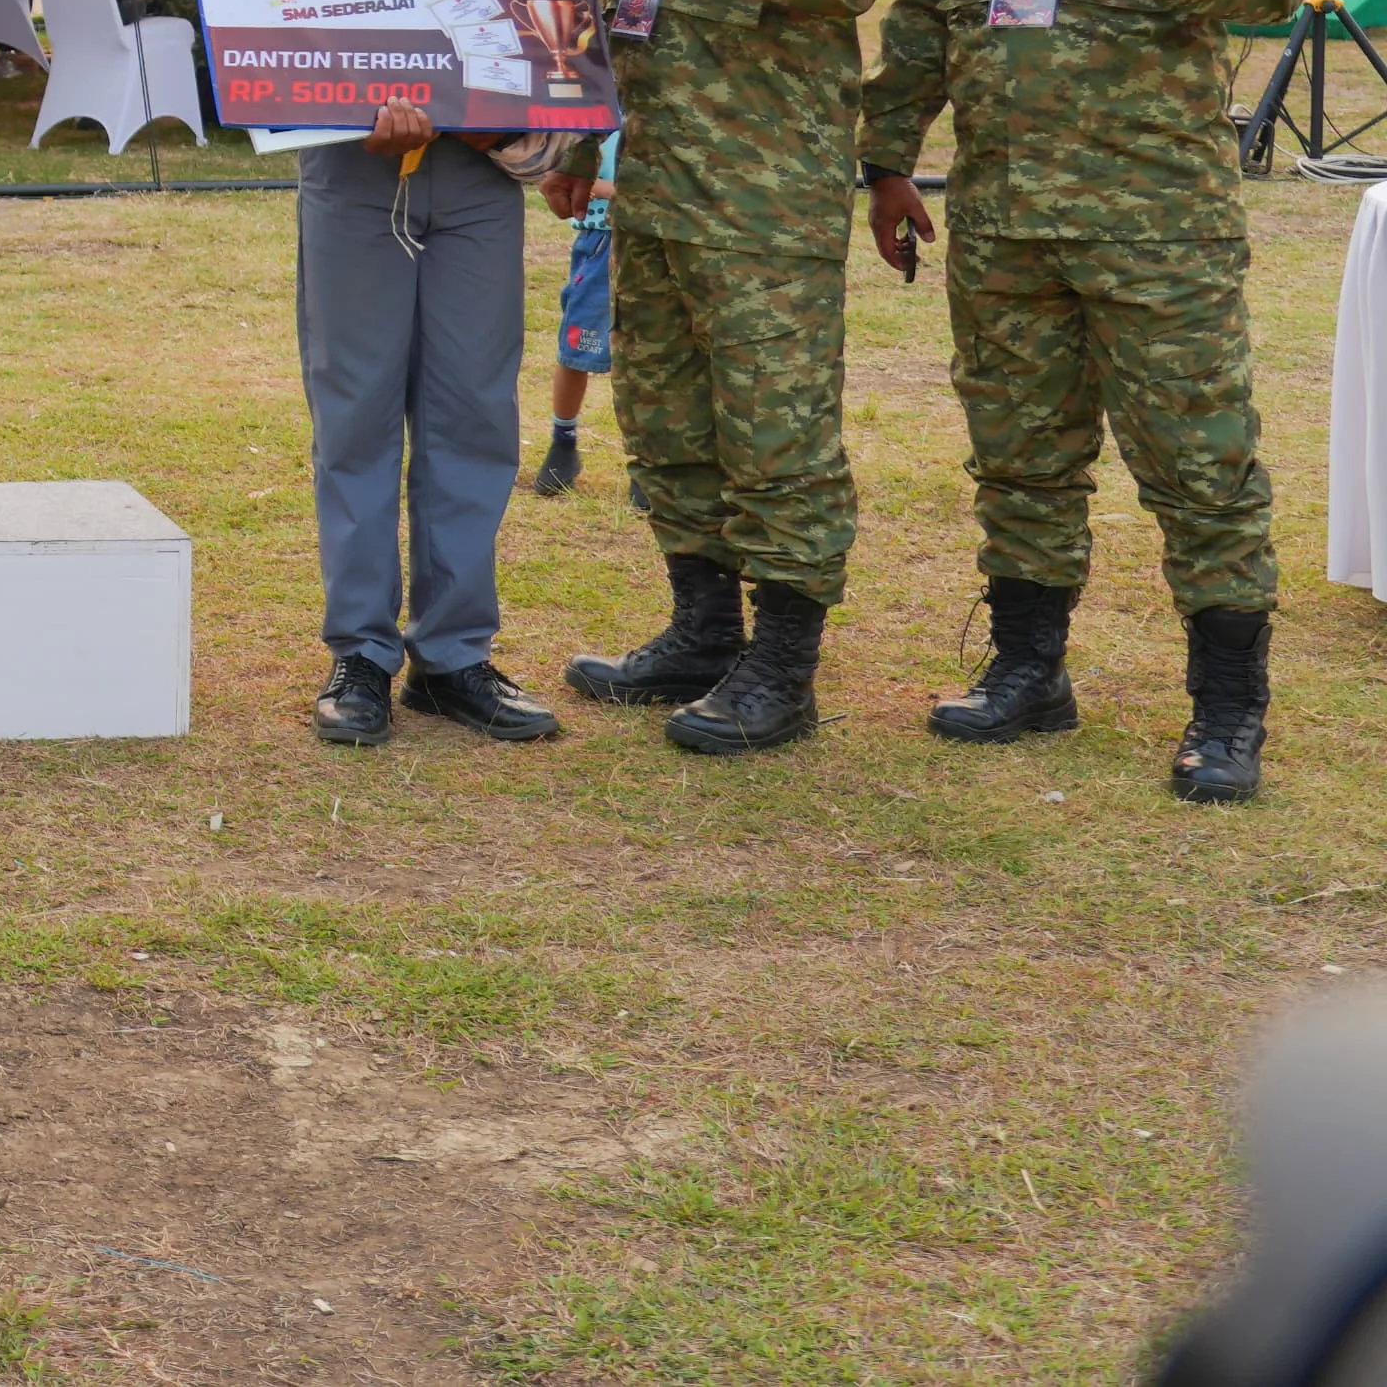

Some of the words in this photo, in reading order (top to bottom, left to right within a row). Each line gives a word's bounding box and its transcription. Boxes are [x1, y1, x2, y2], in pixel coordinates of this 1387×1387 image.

[282, 7, 318, 21] SMA
[223, 50, 331, 69] DANTON
[337, 52, 453, 71] TERBAIK
[229, 79, 281, 103] RP.
[292, 81, 431, 105] 500.000
